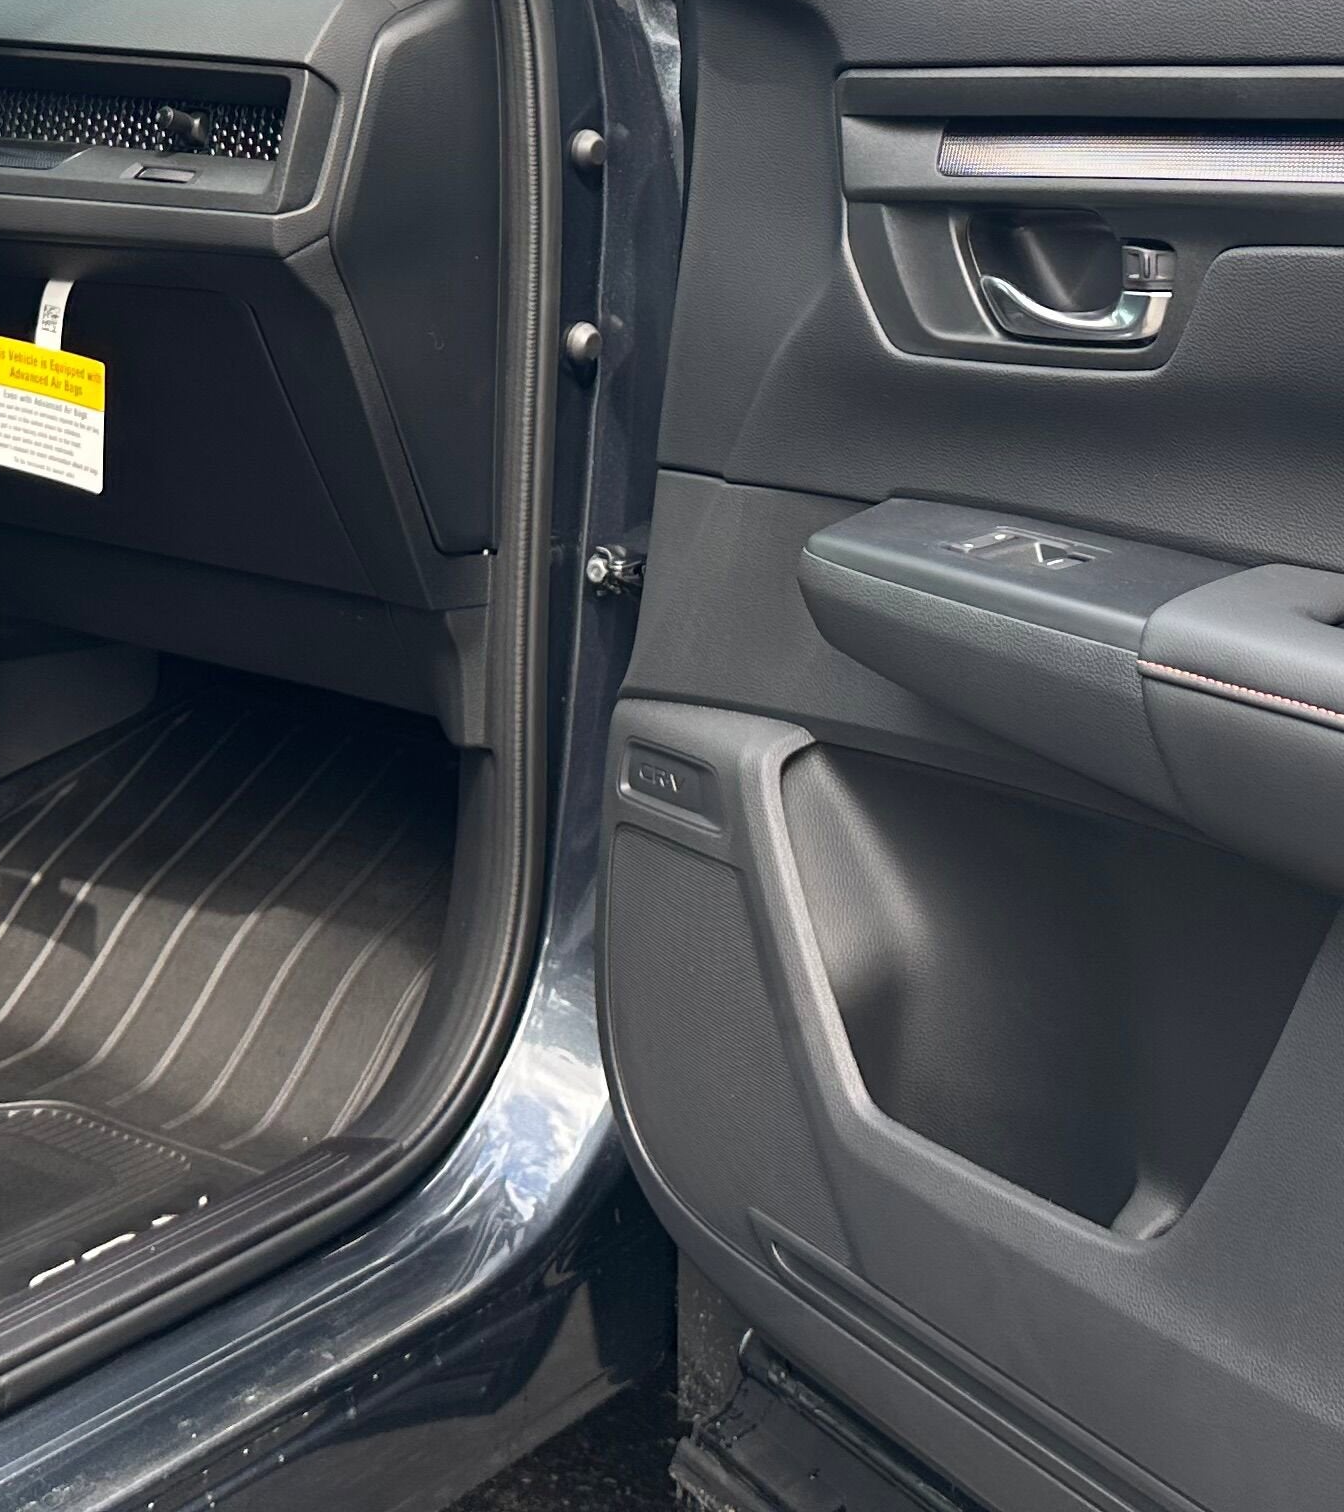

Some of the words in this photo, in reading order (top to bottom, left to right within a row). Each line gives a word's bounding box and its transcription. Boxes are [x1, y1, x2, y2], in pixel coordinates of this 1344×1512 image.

[8, 349, 38, 367] Vehicle
[40, 357, 48, 369] is
[49, 358, 86, 380] Equipped
[9, 366, 49, 387] Advanced
[50, 376, 62, 389] Air
[63, 380, 83, 396] Bags
